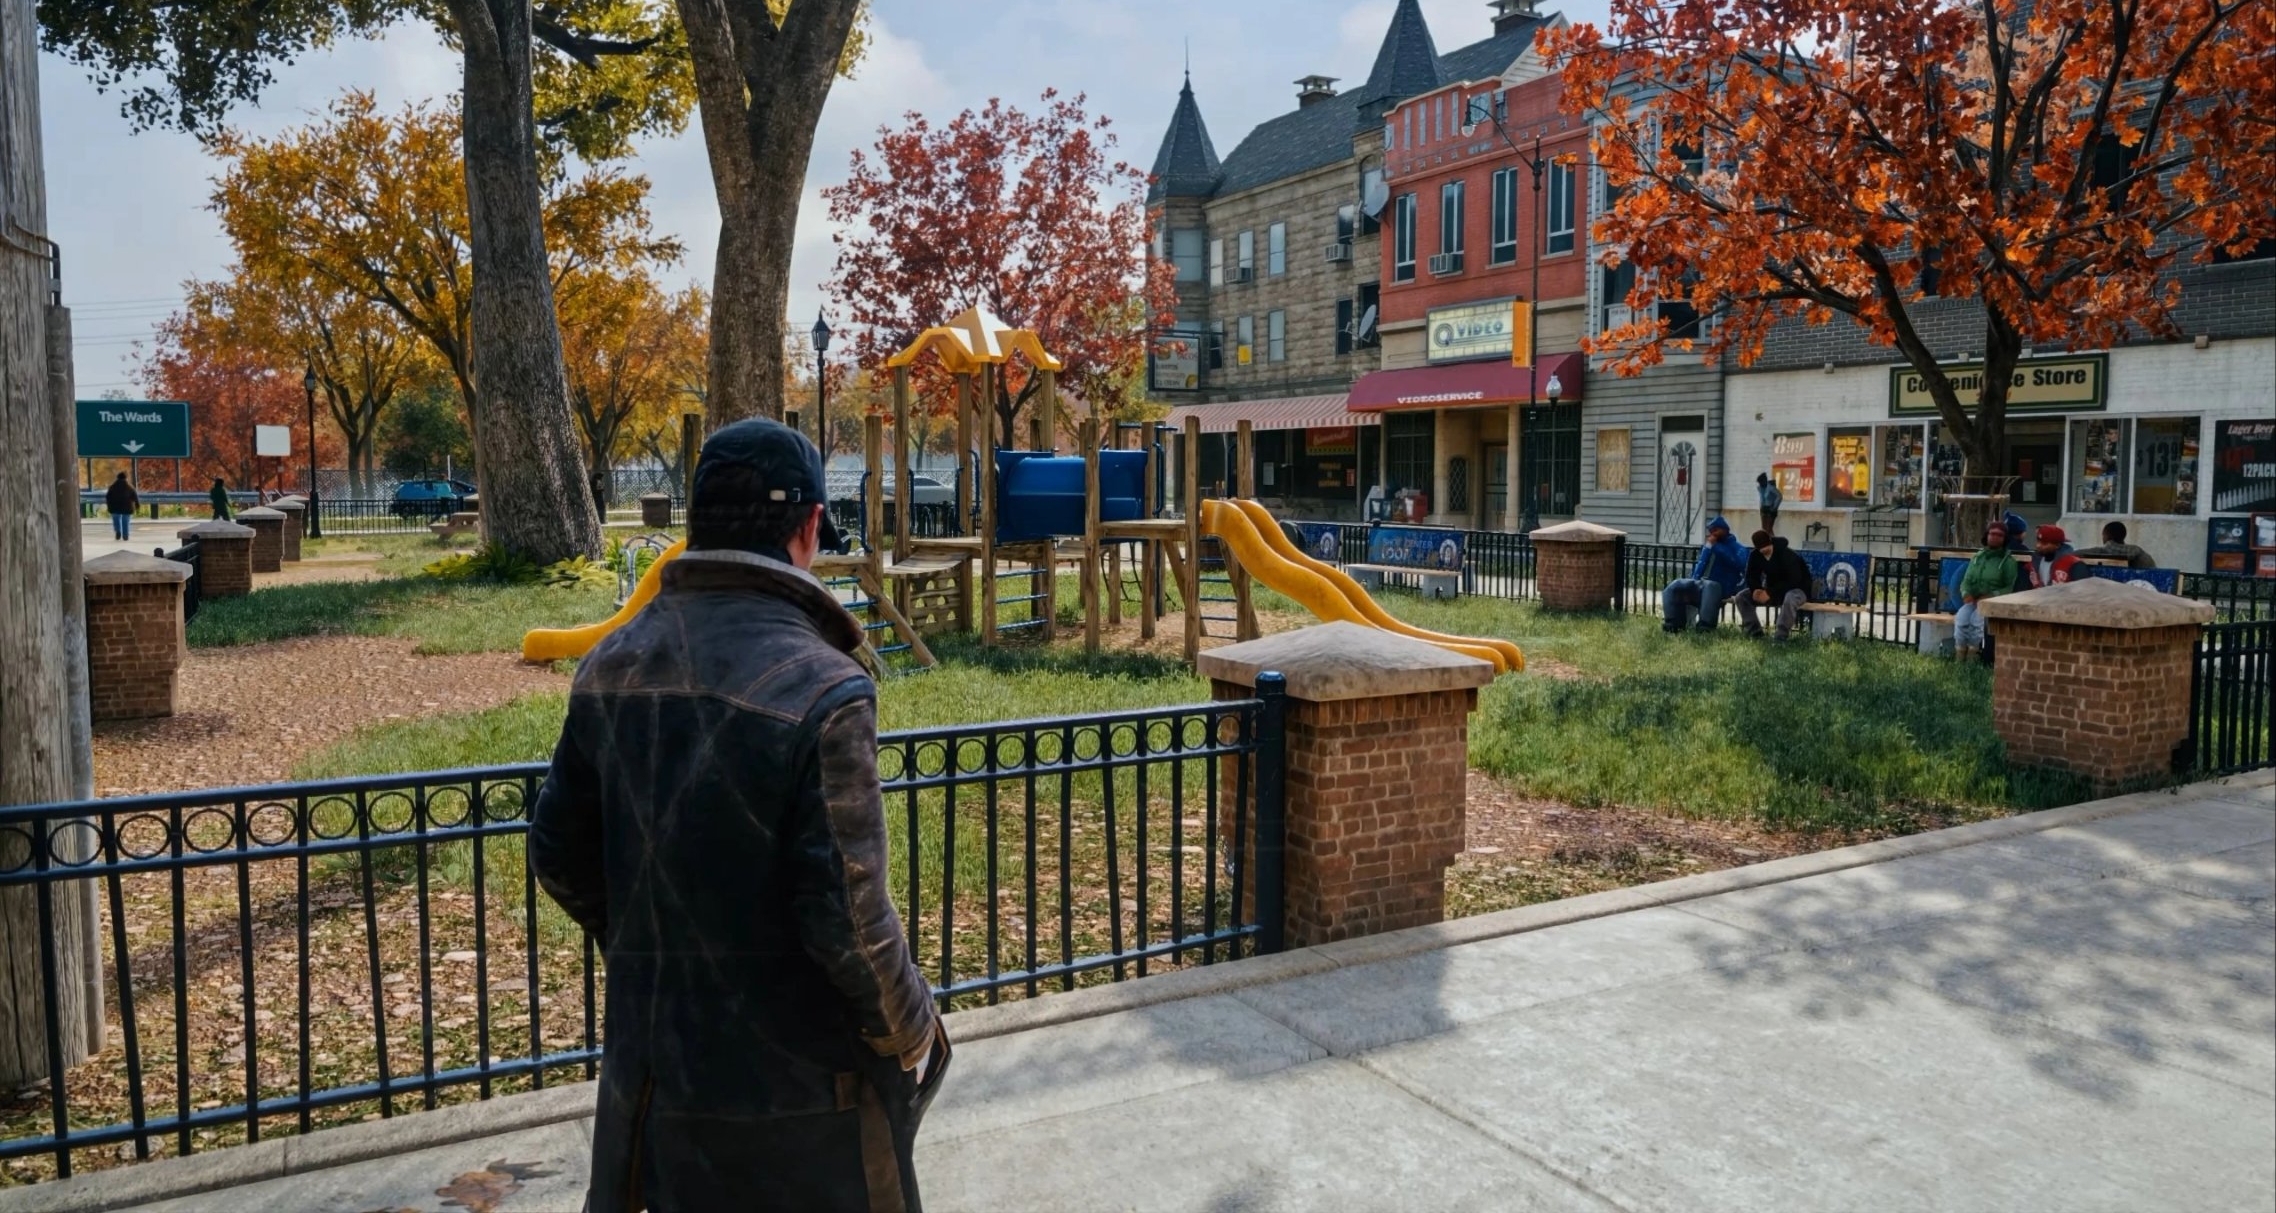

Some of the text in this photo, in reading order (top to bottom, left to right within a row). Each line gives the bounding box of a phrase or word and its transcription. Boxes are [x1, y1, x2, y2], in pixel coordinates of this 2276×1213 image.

[1457, 321, 1504, 337] VIDEO
[1906, 368, 2087, 393] Coenie Store
[1397, 391, 1484, 404] VIDEOSERVICE
[99, 410, 162, 423] The Wards
[2227, 423, 2275, 436] Lager Beer
